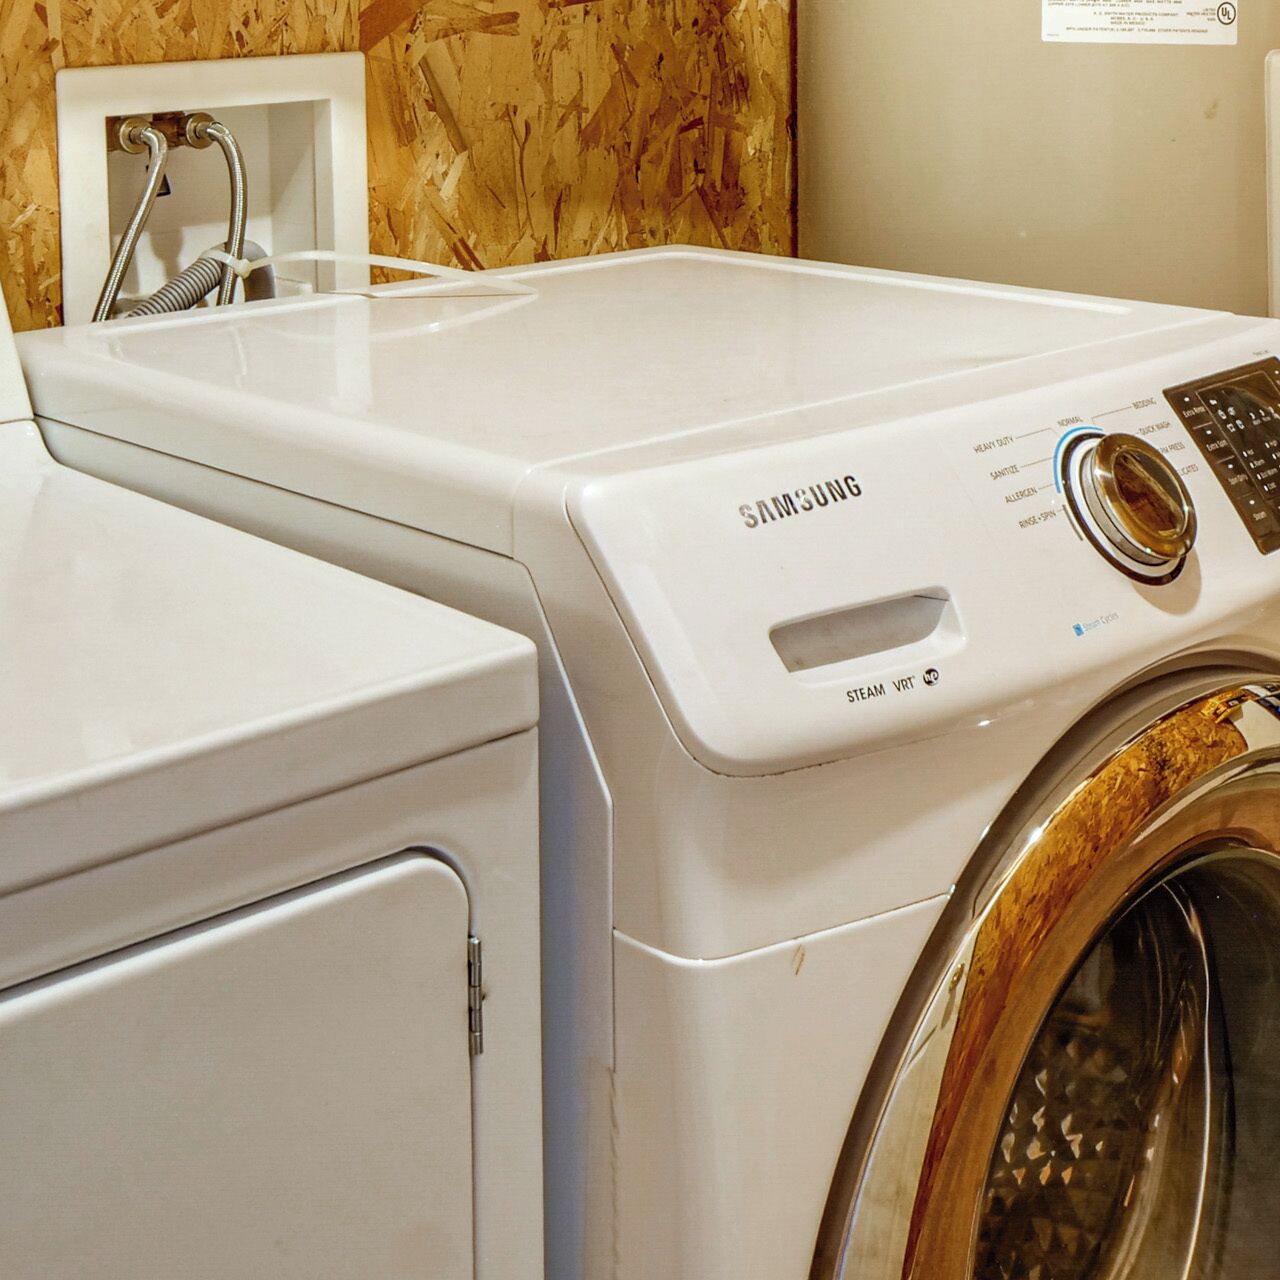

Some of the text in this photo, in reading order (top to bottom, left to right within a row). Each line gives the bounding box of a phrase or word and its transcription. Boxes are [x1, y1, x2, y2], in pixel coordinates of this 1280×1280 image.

[974, 436, 1014, 455] HEAVY DUTY
[1168, 441, 1186, 453] PRESS
[989, 464, 1020, 481] SANITIZE
[738, 474, 863, 529] SAMSUNG
[1004, 486, 1038, 505] ALLERGEN
[846, 683, 886, 703] STEAM
